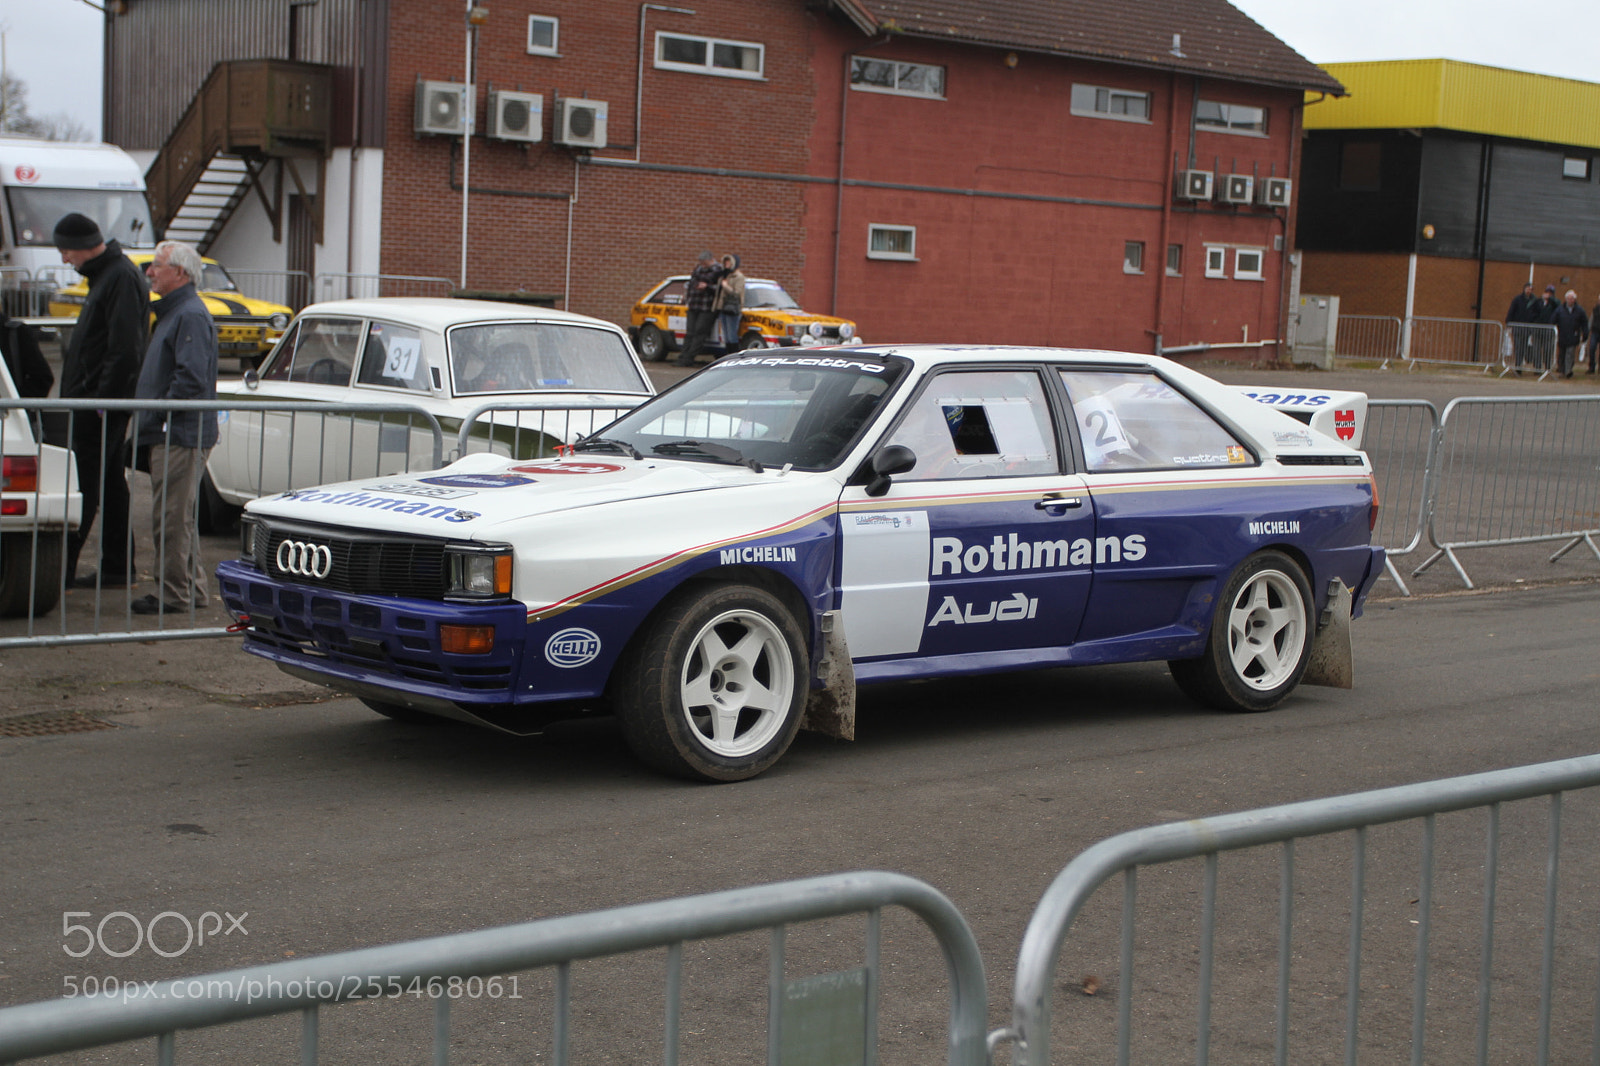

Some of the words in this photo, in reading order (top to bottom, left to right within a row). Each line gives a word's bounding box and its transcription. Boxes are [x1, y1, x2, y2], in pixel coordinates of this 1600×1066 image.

[741, 314, 784, 331] NDREWS
[390, 347, 412, 373] 31
[761, 358, 886, 373] quattro
[1173, 453, 1229, 465] quattro
[272, 489, 482, 523] Rothmans
[1248, 520, 1301, 536] MICHELIN
[720, 547, 797, 565] MICHELIN
[931, 533, 1147, 576] Rothmans
[928, 592, 1039, 627] Audi
[550, 639, 598, 656] HELLA
